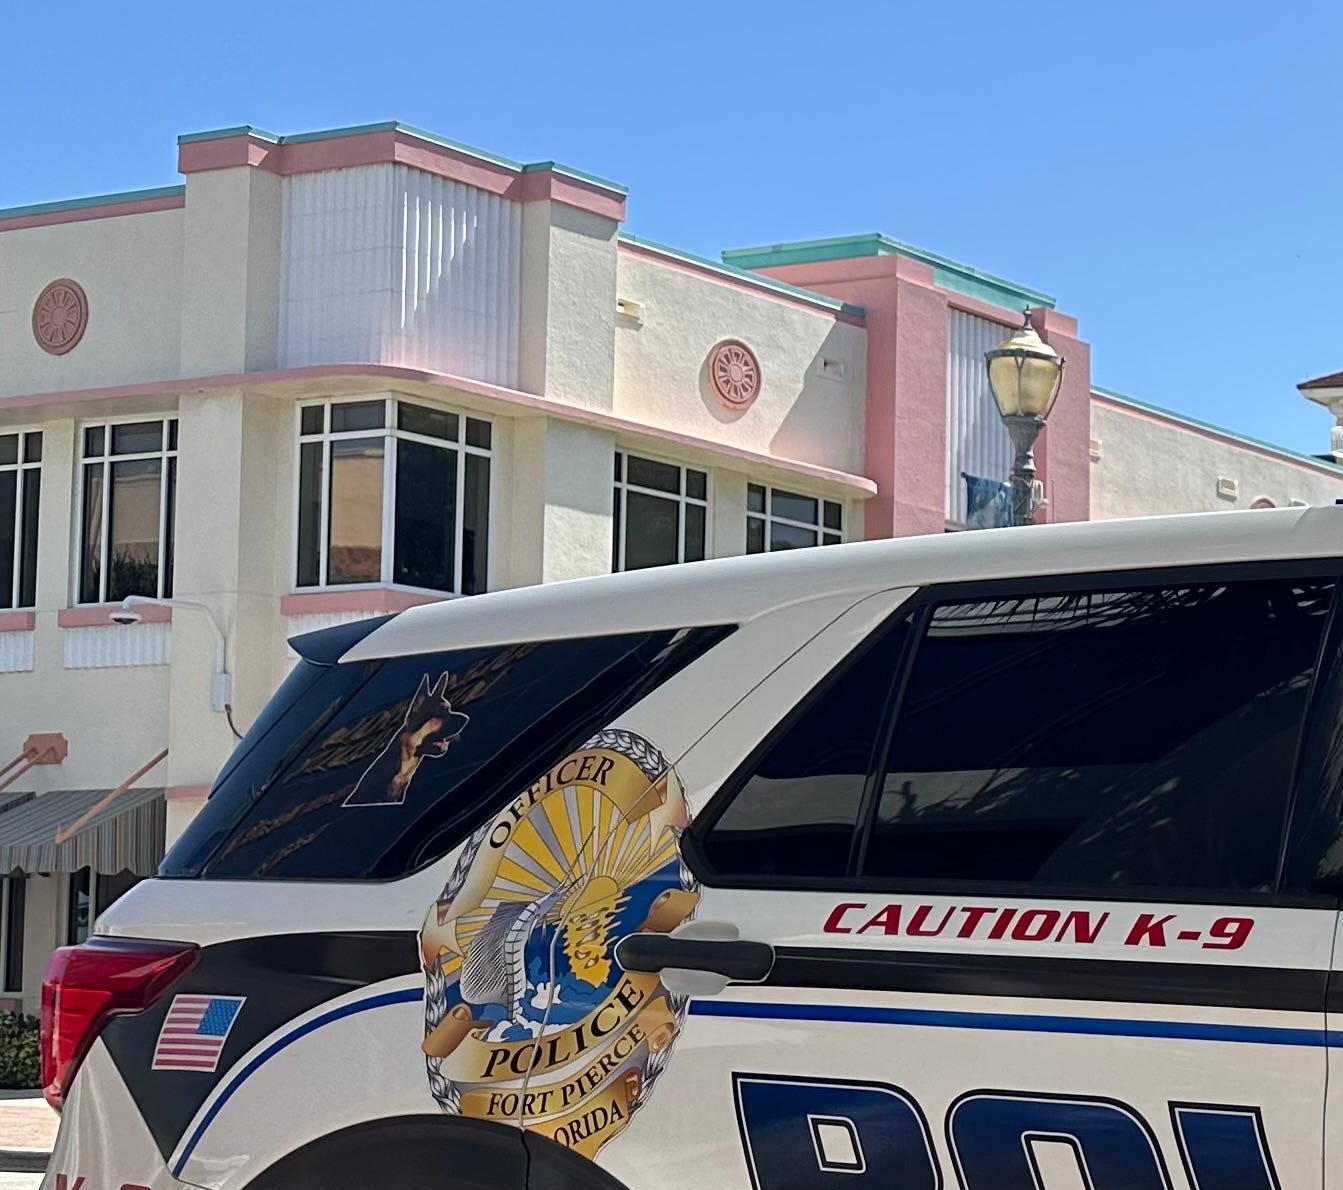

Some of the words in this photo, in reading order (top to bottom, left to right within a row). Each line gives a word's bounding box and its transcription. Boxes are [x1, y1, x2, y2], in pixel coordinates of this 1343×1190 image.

[488, 755, 615, 850] OFFICER
[822, 902, 1110, 944] CAUTION
[1124, 913, 1255, 950] K-9
[481, 977, 645, 1079] POLICE
[486, 1089, 555, 1117] FORT
[561, 1024, 647, 1107] PIERCE
[545, 1098, 625, 1147] ORIDA
